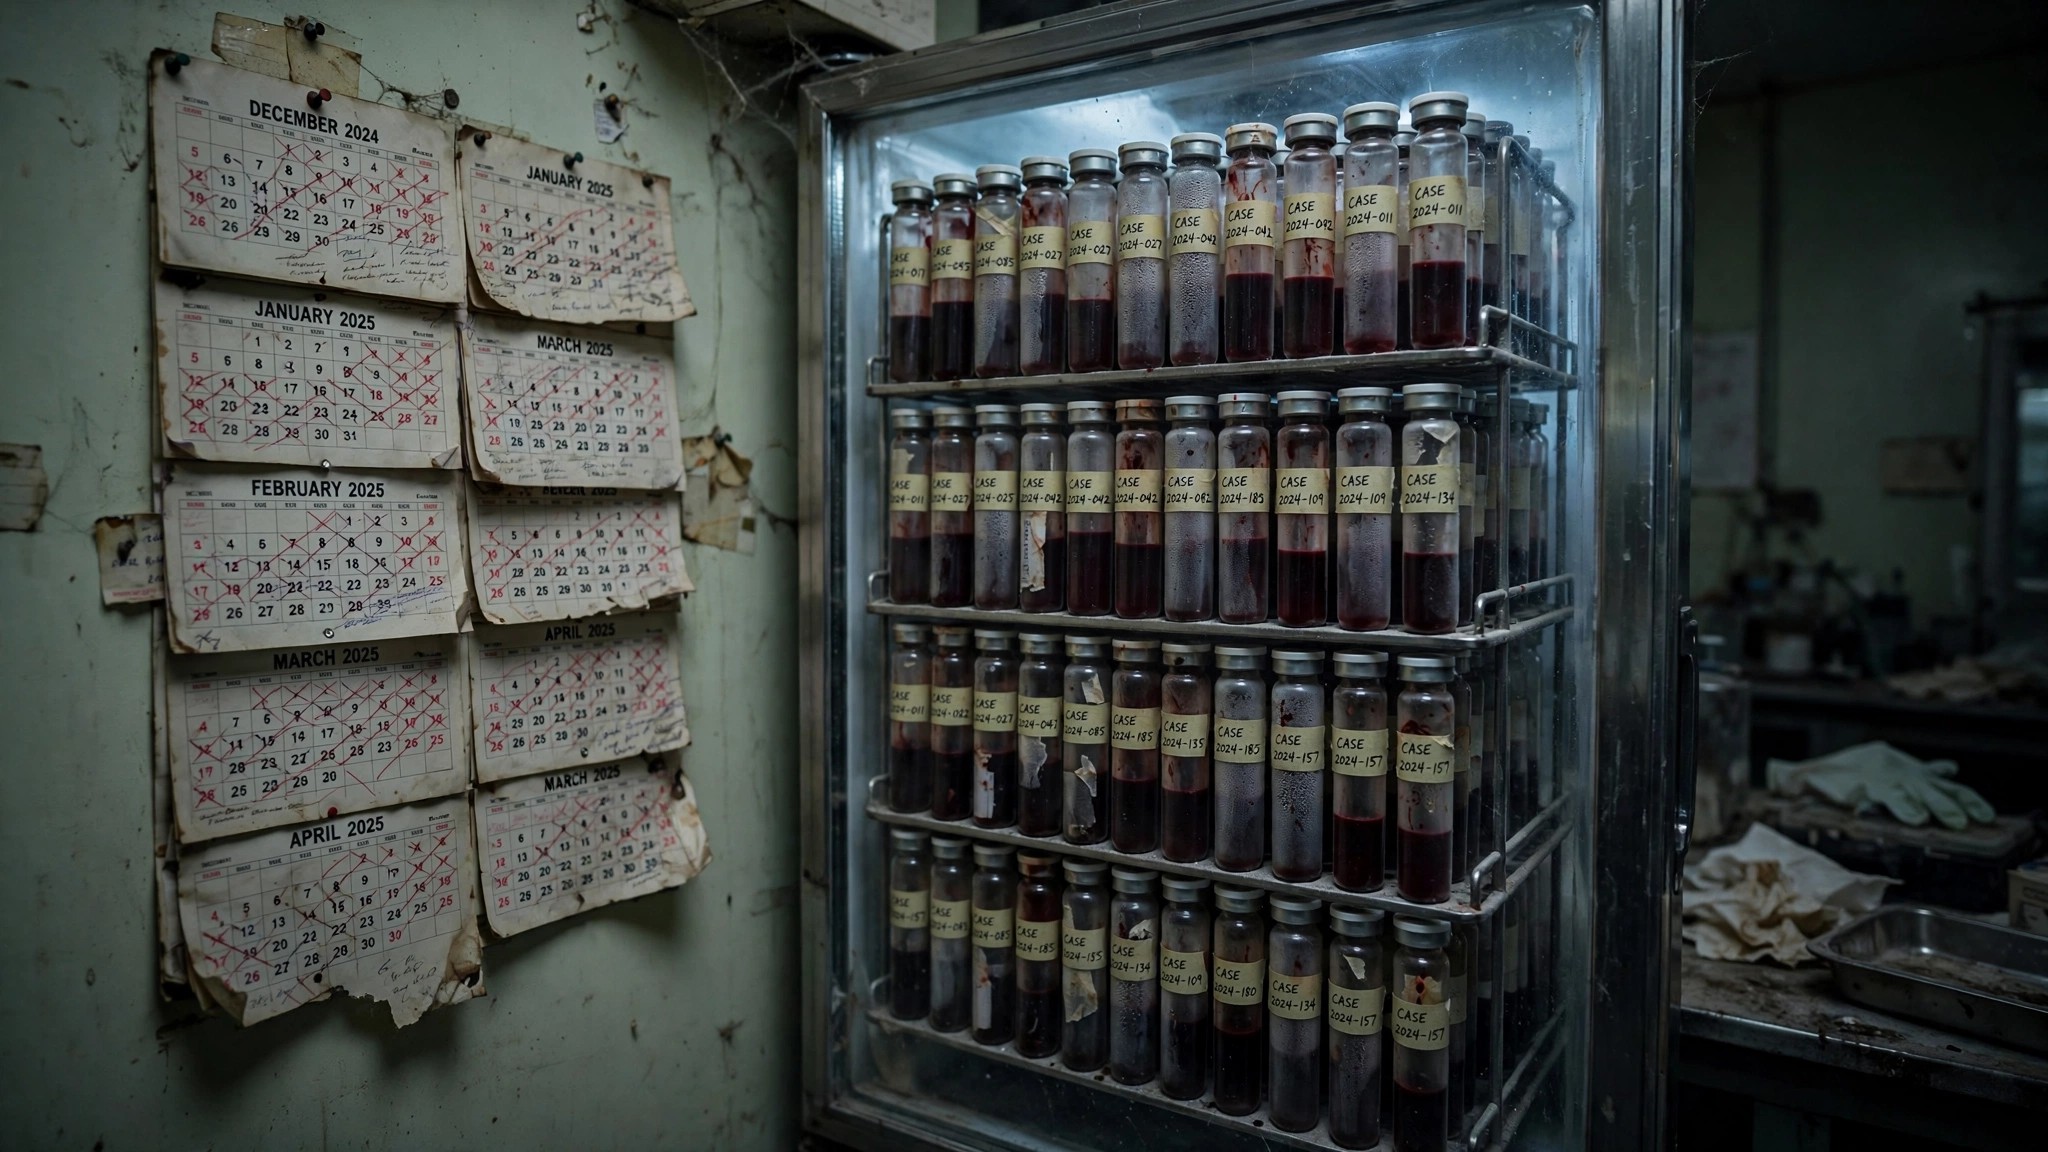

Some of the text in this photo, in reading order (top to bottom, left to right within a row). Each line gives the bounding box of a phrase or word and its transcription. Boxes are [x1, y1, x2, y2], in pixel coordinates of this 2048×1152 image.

[249, 99, 338, 136] DECEMBER
[345, 123, 380, 144] 2024
[191, 146, 293, 176] 5 6 7 8
[342, 156, 378, 173] 3 4
[527, 166, 614, 197] JANUARY 2025
[220, 174, 355, 209] 13 17
[1415, 184, 1445, 201] CASE
[1288, 200, 1315, 215] CASE
[1348, 193, 1378, 209] CASE
[220, 197, 329, 226] 20 22 23
[1228, 208, 1254, 222] CASE
[1412, 203, 1463, 219] 2024-011
[1175, 216, 1201, 229] CASE
[1346, 211, 1393, 227] 2024-011
[1071, 228, 1092, 241] CASE
[1120, 222, 1144, 236] CASE
[568, 240, 579, 249] 17
[1022, 233, 1044, 246] CASE
[1119, 239, 1162, 252] 2024-027
[1172, 232, 1217, 246] 2024-042
[1020, 250, 1063, 262] 2024-027
[1069, 245, 1111, 257] 2024-027
[255, 300, 334, 325] JANUARY
[340, 311, 375, 331] 2025
[255, 336, 292, 350] 1 2
[537, 335, 614, 356] MARCH 2025
[223, 355, 323, 375] 6 9
[284, 383, 298, 395] 17
[615, 407, 624, 416] 17
[314, 428, 357, 441] 30 31
[975, 478, 996, 488] CASE
[1022, 477, 1044, 488] CASE
[1069, 478, 1092, 489] CASE
[1117, 477, 1140, 487] CASE
[1168, 476, 1195, 487] CASE
[1221, 475, 1248, 487] CASE
[1280, 476, 1307, 488] CASE
[1341, 475, 1370, 486] CASE
[1406, 473, 1437, 485] CASE
[251, 479, 385, 498] FEBRUARY 2025
[1115, 492, 1158, 503] 2024-042
[1220, 493, 1264, 506] 2024-185
[1279, 493, 1324, 506] 2024-109
[1339, 492, 1386, 505] 2024-109
[1404, 491, 1455, 505] 2024-134
[401, 516, 408, 526] 3
[512, 531, 517, 540] 5
[227, 536, 382, 549] 4 9
[597, 547, 607, 555] 17
[402, 577, 417, 589] 24
[580, 584, 592, 593] 30
[226, 605, 305, 619] 26 27 28
[545, 623, 615, 642] APRIL 2025
[273, 649, 337, 670] MARCH
[343, 646, 379, 665] 2025
[512, 681, 518, 689] 4
[232, 703, 359, 727] 7 9
[1019, 703, 1040, 714] CASE
[1065, 709, 1088, 721] CASE
[533, 717, 545, 725] 20
[554, 713, 566, 722] 22
[1113, 714, 1137, 726] CASE
[1164, 720, 1188, 732] CASE
[1218, 727, 1244, 738] CASE
[320, 727, 335, 739] 17
[1112, 731, 1154, 742] 2024-185
[513, 738, 525, 747] 26
[1162, 738, 1205, 749] 2024-135
[1275, 734, 1302, 746] CASE
[1336, 738, 1365, 749] CASE
[1216, 742, 1260, 755] 2024-185
[1401, 742, 1431, 755] CASE
[1273, 750, 1320, 763] 2024-157
[1334, 754, 1383, 767] 2024-157
[1399, 760, 1450, 774] 2024-157
[544, 765, 620, 792] MARCH 2025
[289, 824, 340, 849] APRIL
[348, 815, 384, 838] 2025
[518, 834, 524, 843] 6
[361, 875, 369, 886] 9
[518, 871, 530, 882] 20
[272, 917, 286, 929] 13
[1016, 925, 1039, 938] CASE
[272, 939, 288, 952] 20
[361, 936, 376, 949] 30
[1064, 934, 1086, 947] CASE
[1112, 944, 1134, 957] CASE
[1163, 956, 1186, 969] CASE
[1161, 971, 1202, 986] 2024-109
[1215, 966, 1240, 981] CASE
[1272, 980, 1299, 994] CASE
[1271, 996, 1316, 1012] 2024-134
[1332, 993, 1359, 1009] CASE
[1330, 1009, 1377, 1026] 2024-157
[1397, 1007, 1427, 1024] CASE
[1395, 1024, 1445, 1042] 2024-157
